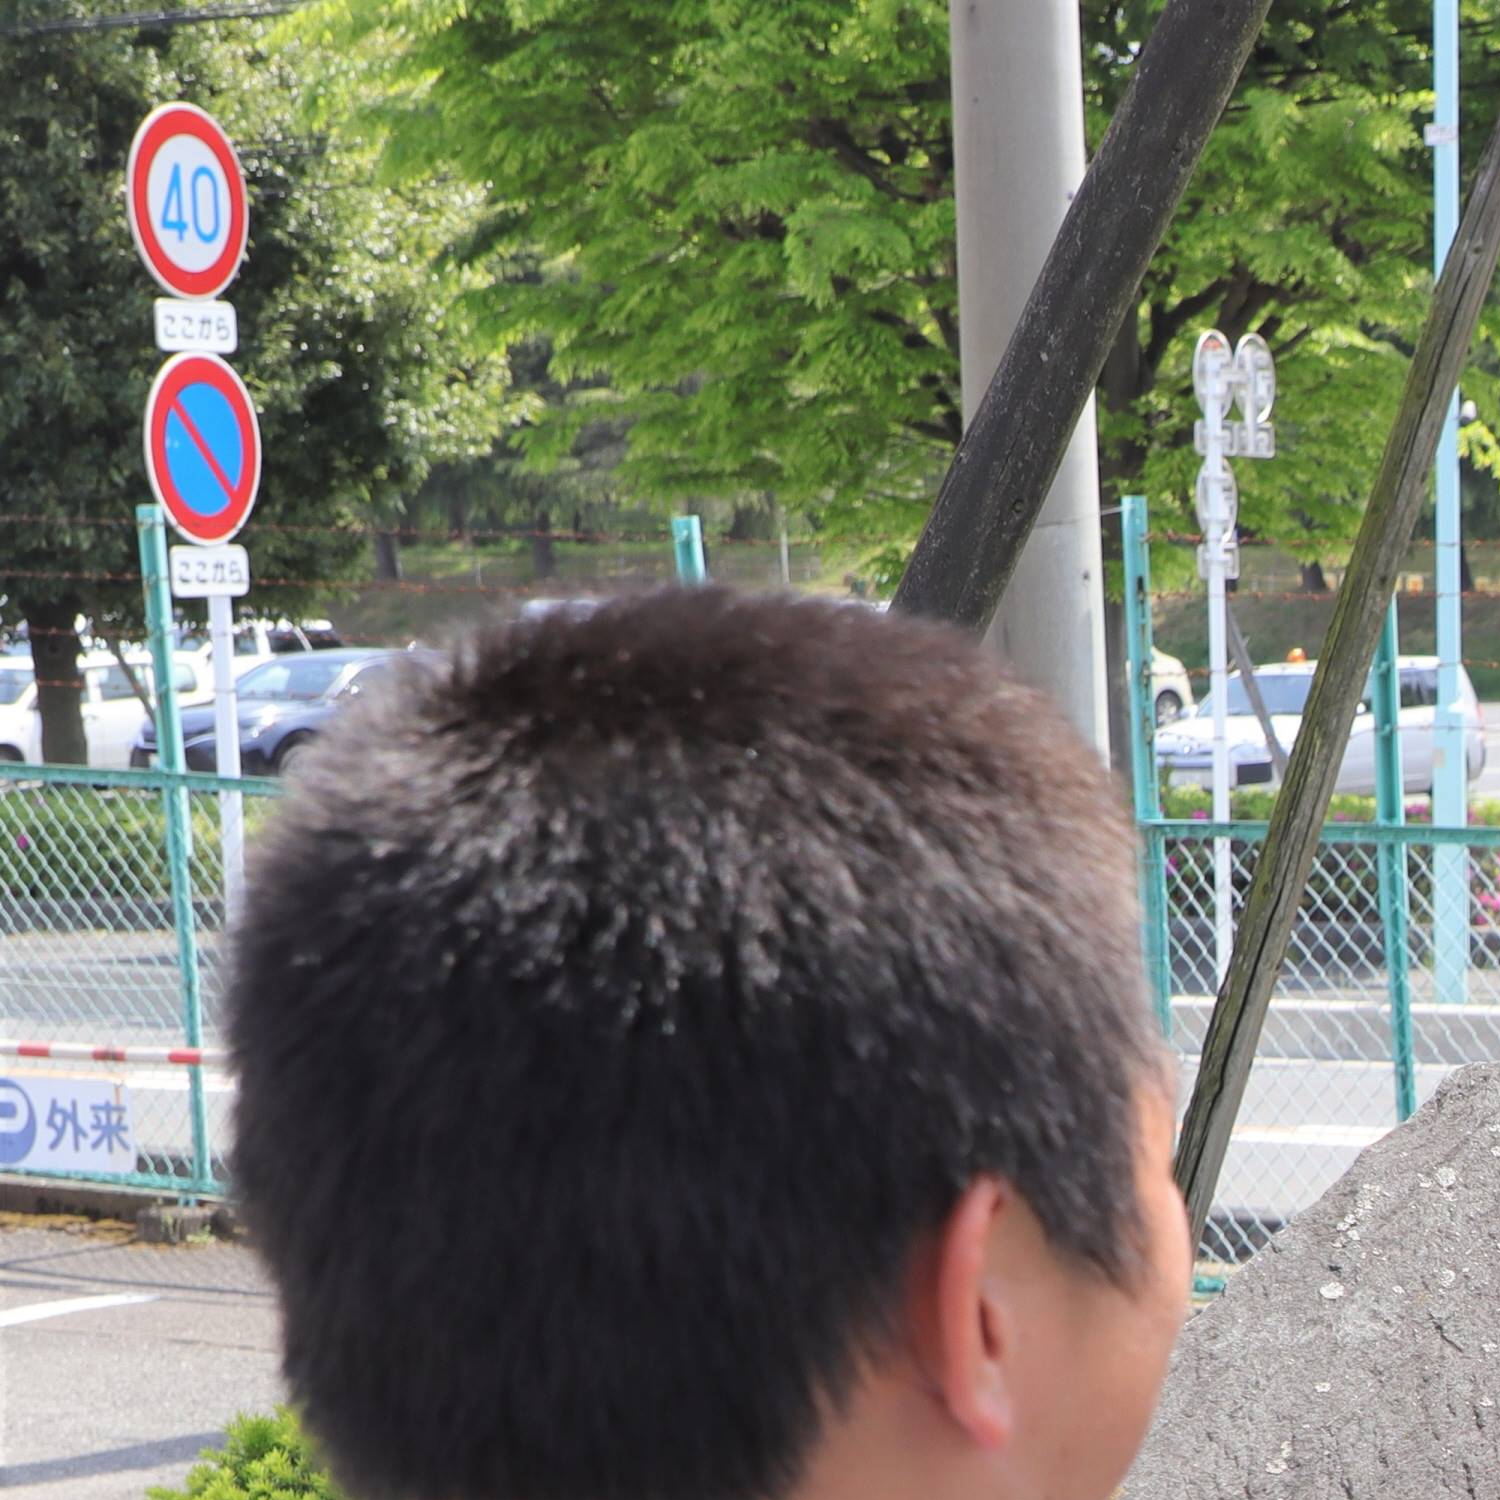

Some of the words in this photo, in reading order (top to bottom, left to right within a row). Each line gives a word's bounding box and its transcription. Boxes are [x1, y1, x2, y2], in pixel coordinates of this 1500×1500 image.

[162, 163, 220, 243] 40
[163, 314, 231, 341] ここから
[179, 560, 244, 584] ここから
[46, 1097, 130, 1153] 外来
